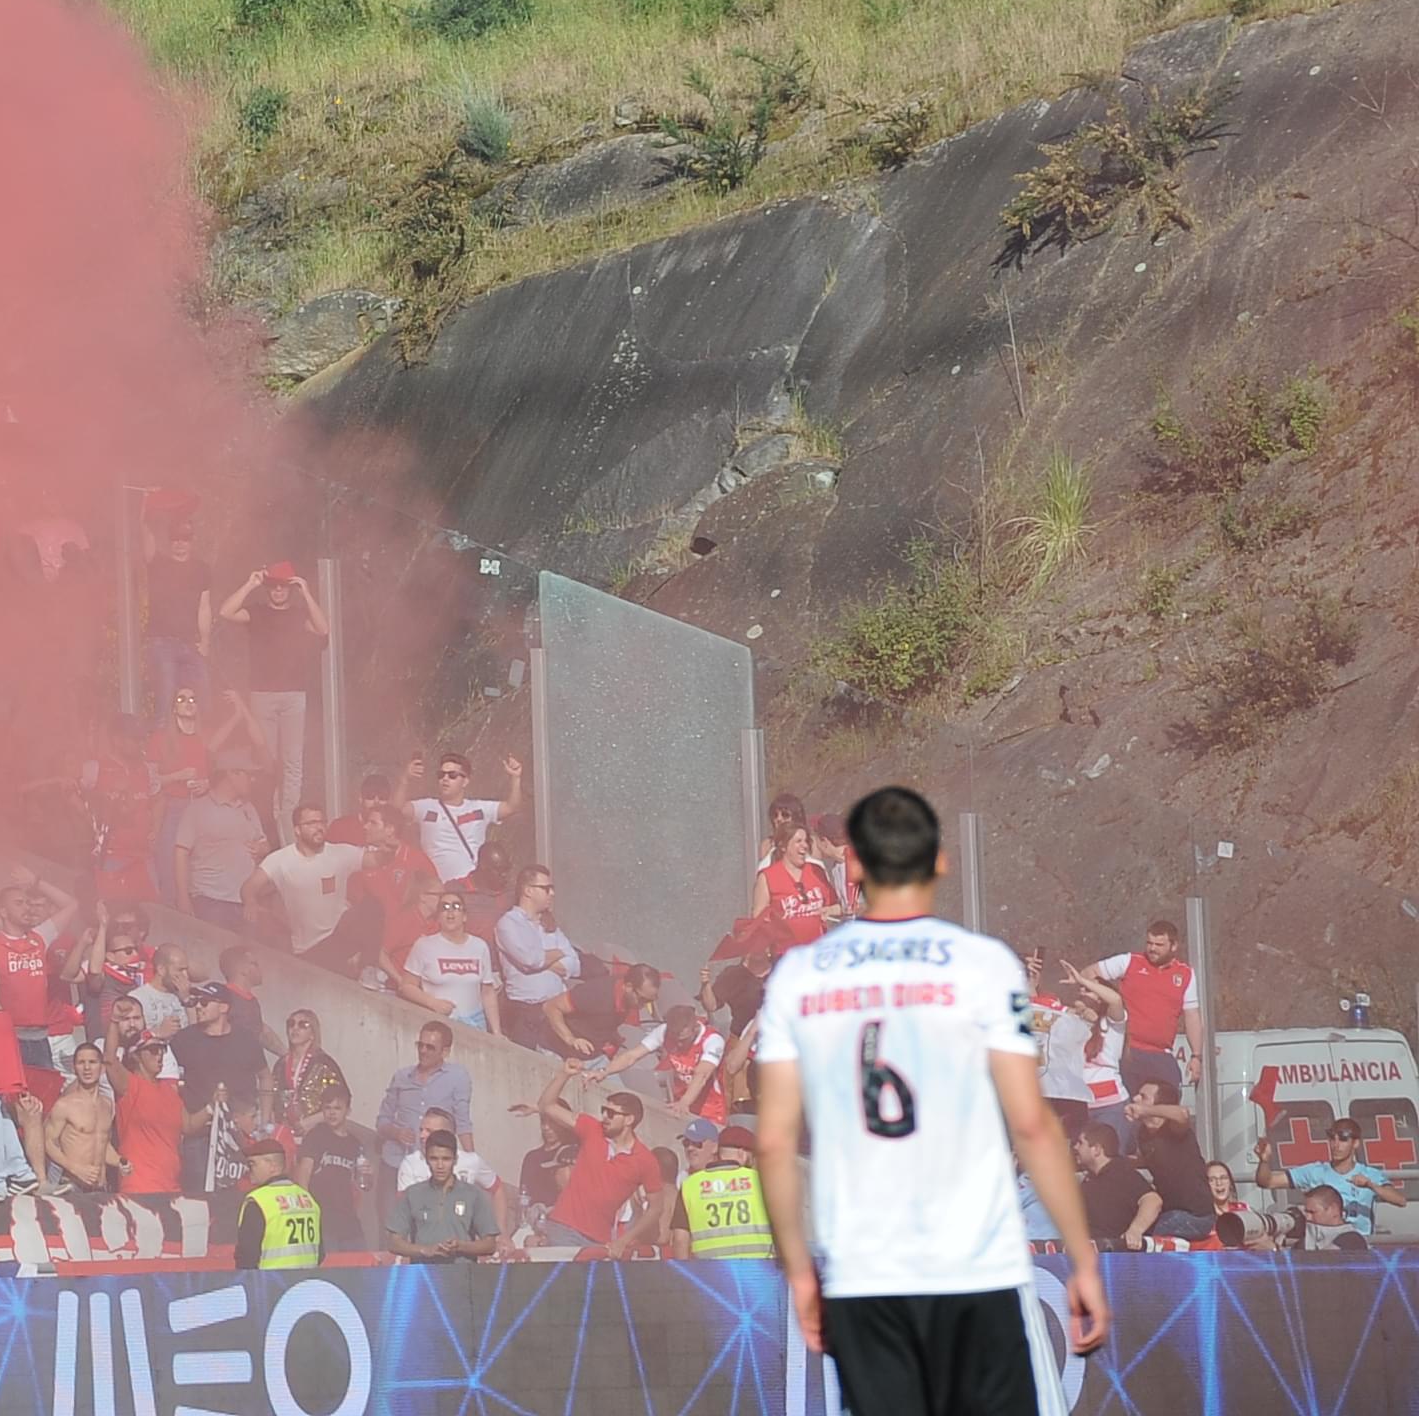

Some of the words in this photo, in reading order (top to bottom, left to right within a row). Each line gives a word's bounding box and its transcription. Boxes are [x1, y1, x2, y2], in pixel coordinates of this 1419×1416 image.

[846, 937, 954, 967] SAGRES
[860, 1021, 916, 1140] 6
[1277, 1059, 1402, 1085] MBULÂNCIA
[699, 1177, 752, 1195] 2045
[705, 1199, 752, 1228] 378
[286, 1217, 315, 1245] 276
